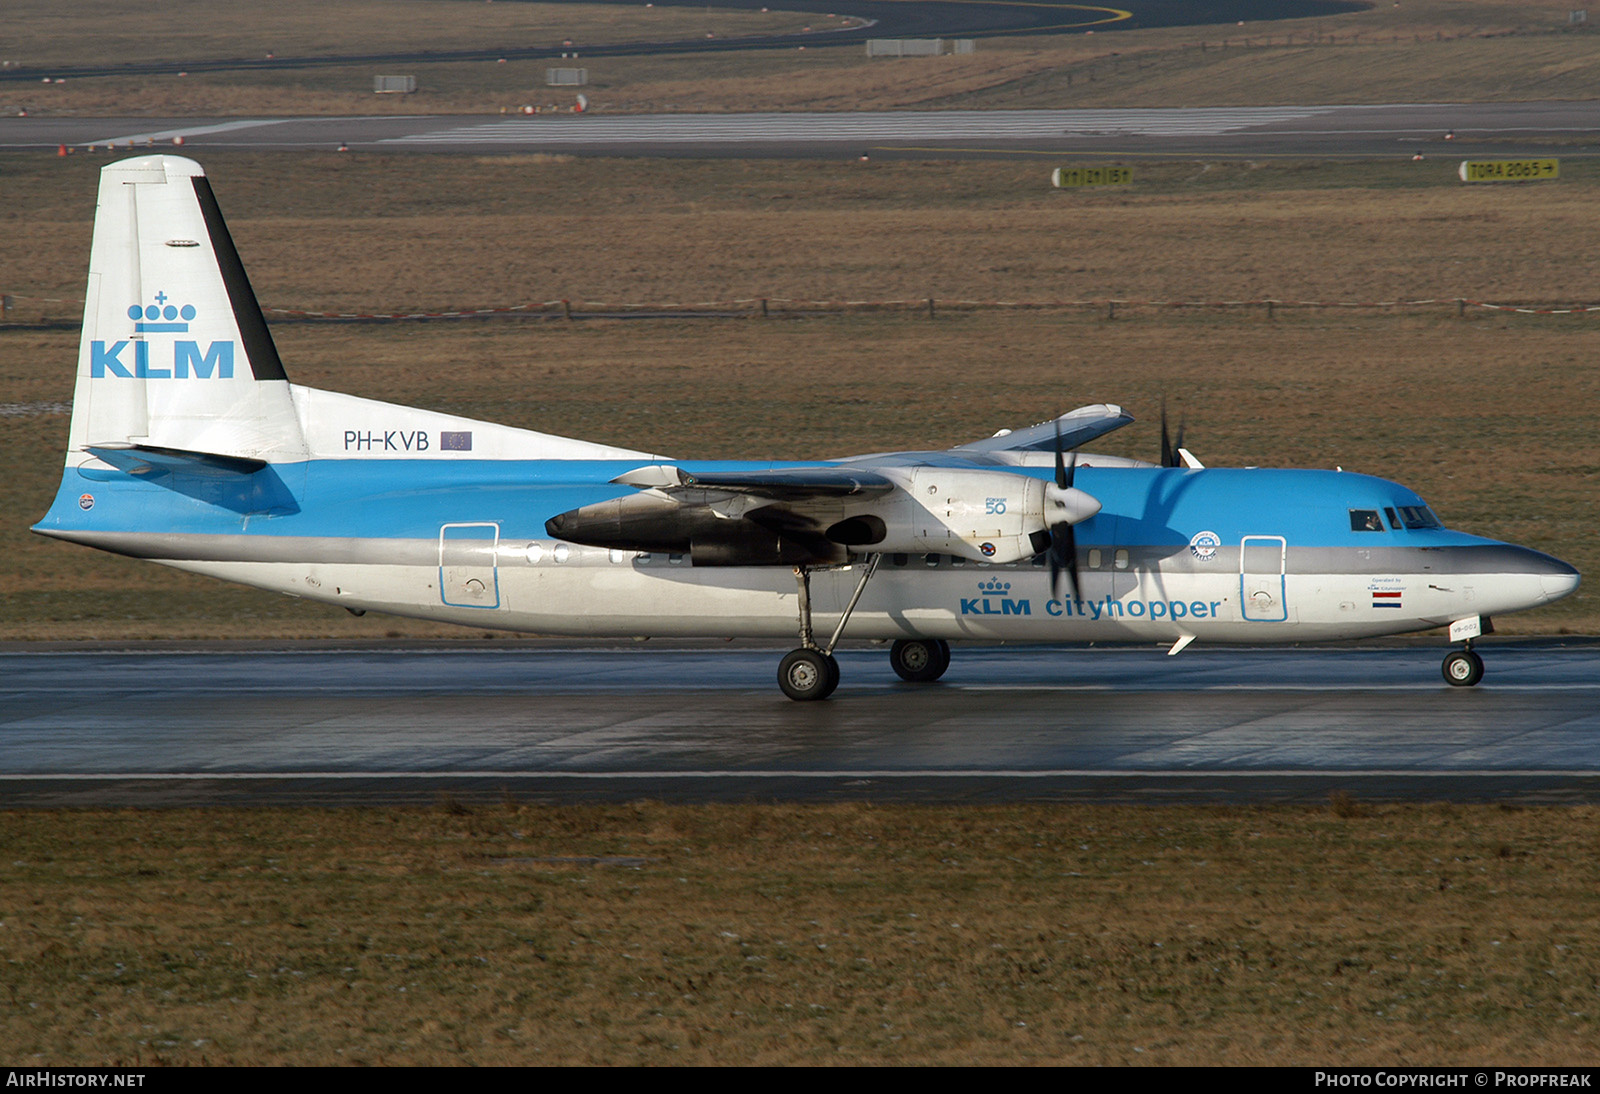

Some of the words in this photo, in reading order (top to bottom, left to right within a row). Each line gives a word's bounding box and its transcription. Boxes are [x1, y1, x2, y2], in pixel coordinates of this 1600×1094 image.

[1471, 164, 1503, 178] TORA
[1507, 162, 1540, 177] 2065
[91, 340, 234, 379] KLM
[344, 431, 430, 451] PH-KVB
[986, 502, 1006, 515] 50
[960, 598, 1032, 616] KLM
[1046, 594, 1222, 621] cityhopper
